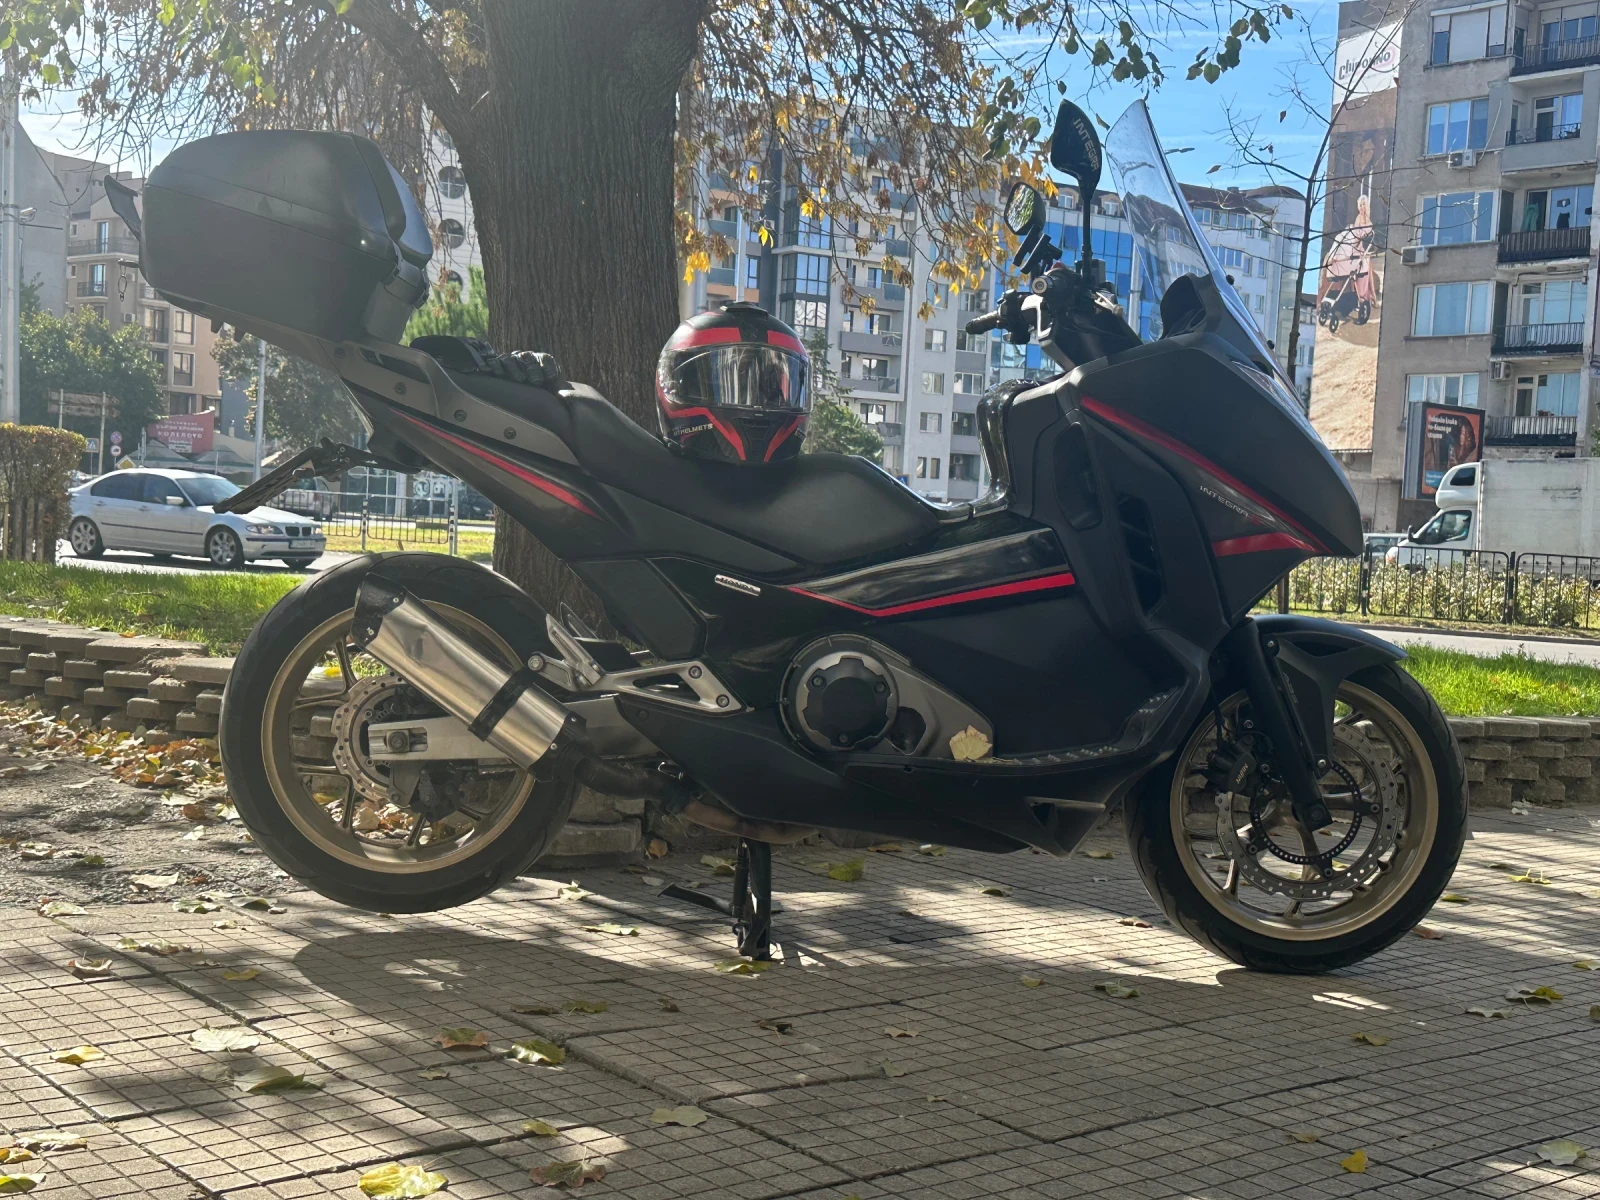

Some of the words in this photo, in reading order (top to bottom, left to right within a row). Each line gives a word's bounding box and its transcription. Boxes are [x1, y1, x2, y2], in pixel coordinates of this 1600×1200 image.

[1073, 118, 1100, 172] INTEGRA
[680, 423, 713, 435] HELMETS
[1199, 485, 1249, 518] INTEGRA
